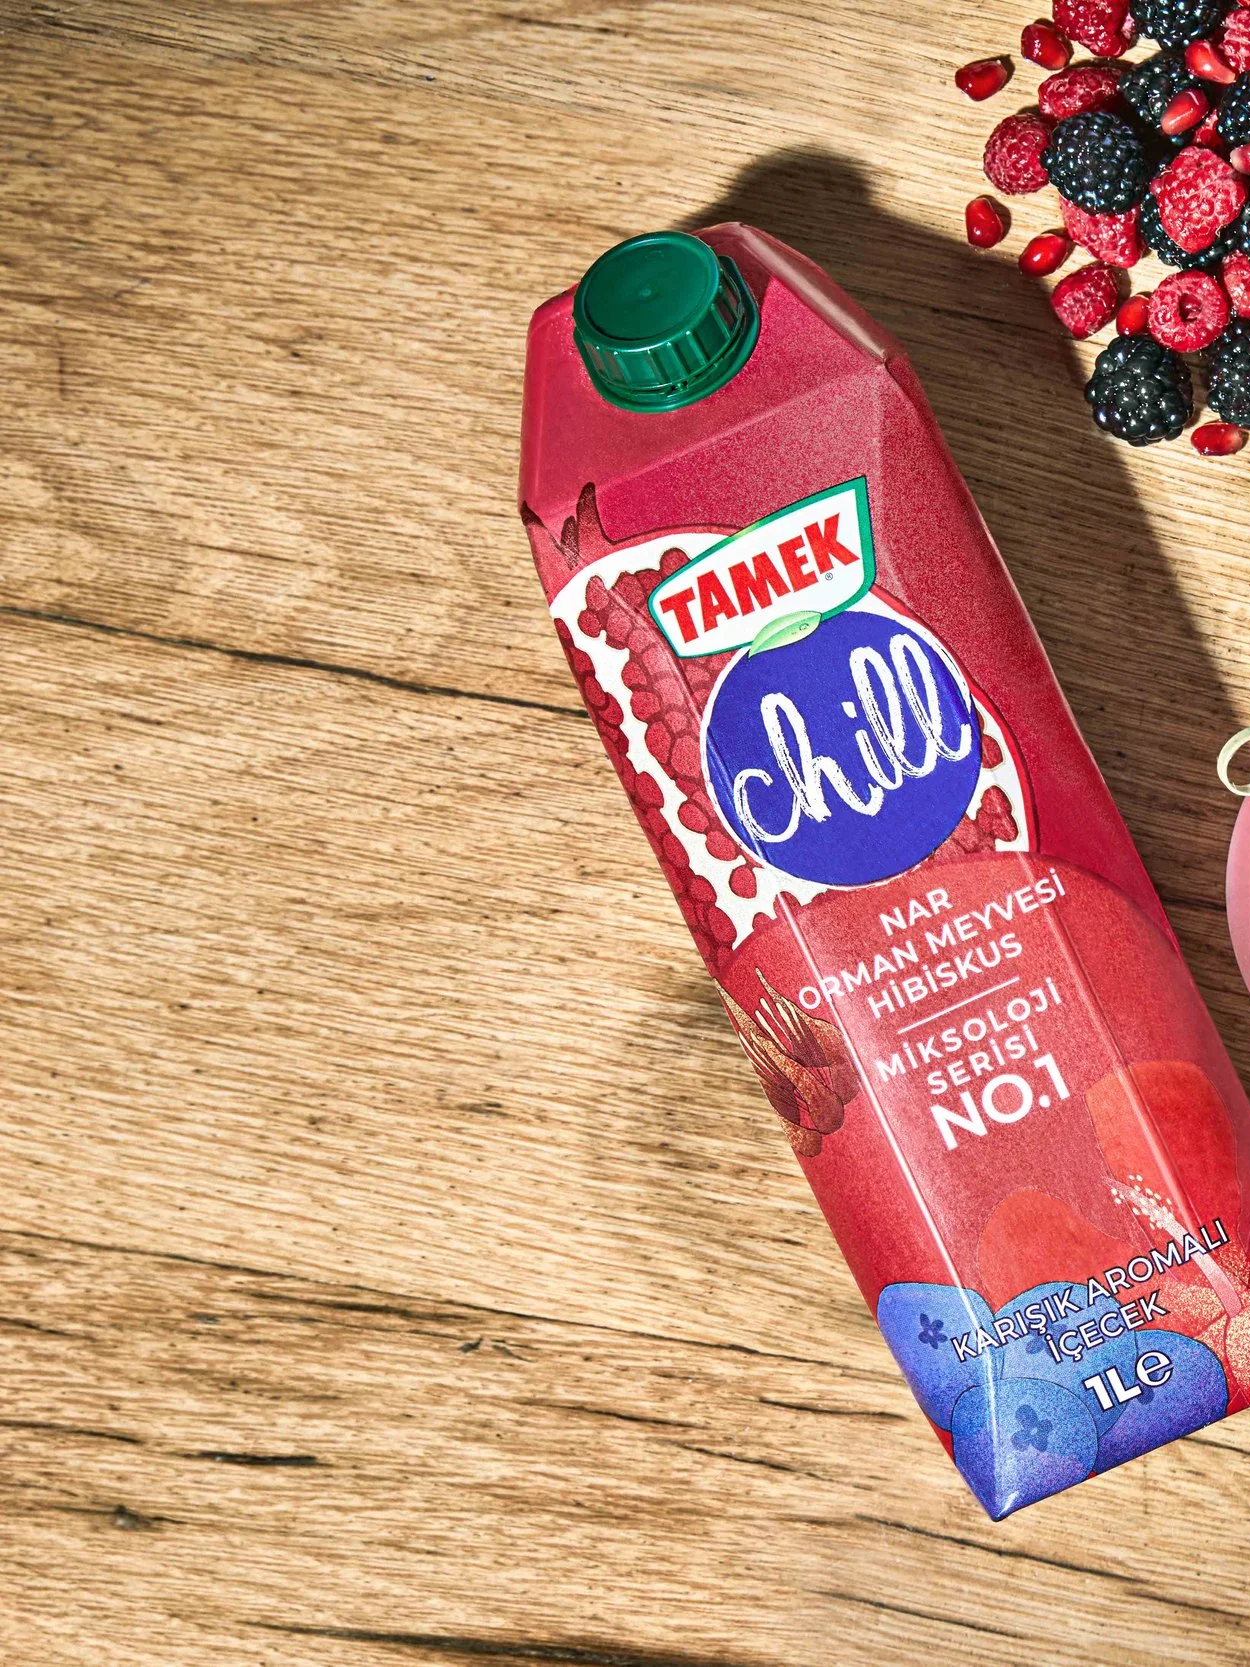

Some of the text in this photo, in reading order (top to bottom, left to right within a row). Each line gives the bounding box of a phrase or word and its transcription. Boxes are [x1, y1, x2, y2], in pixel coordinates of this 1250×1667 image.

[659, 513, 860, 643] TAMEK
[733, 633, 972, 844] chill
[798, 867, 1067, 1011] ORMAN MEYVESİ
[879, 887, 953, 936] NAR
[867, 932, 1024, 1020] HİBİSKUS
[874, 977, 1063, 1083] MİKSOLOJİ
[927, 1024, 1039, 1095] SERİSİ
[930, 1053, 1071, 1151] NO.1
[950, 1217, 1231, 1364] KARIŞIK AROMALI
[1043, 1289, 1170, 1365] İÇECEK
